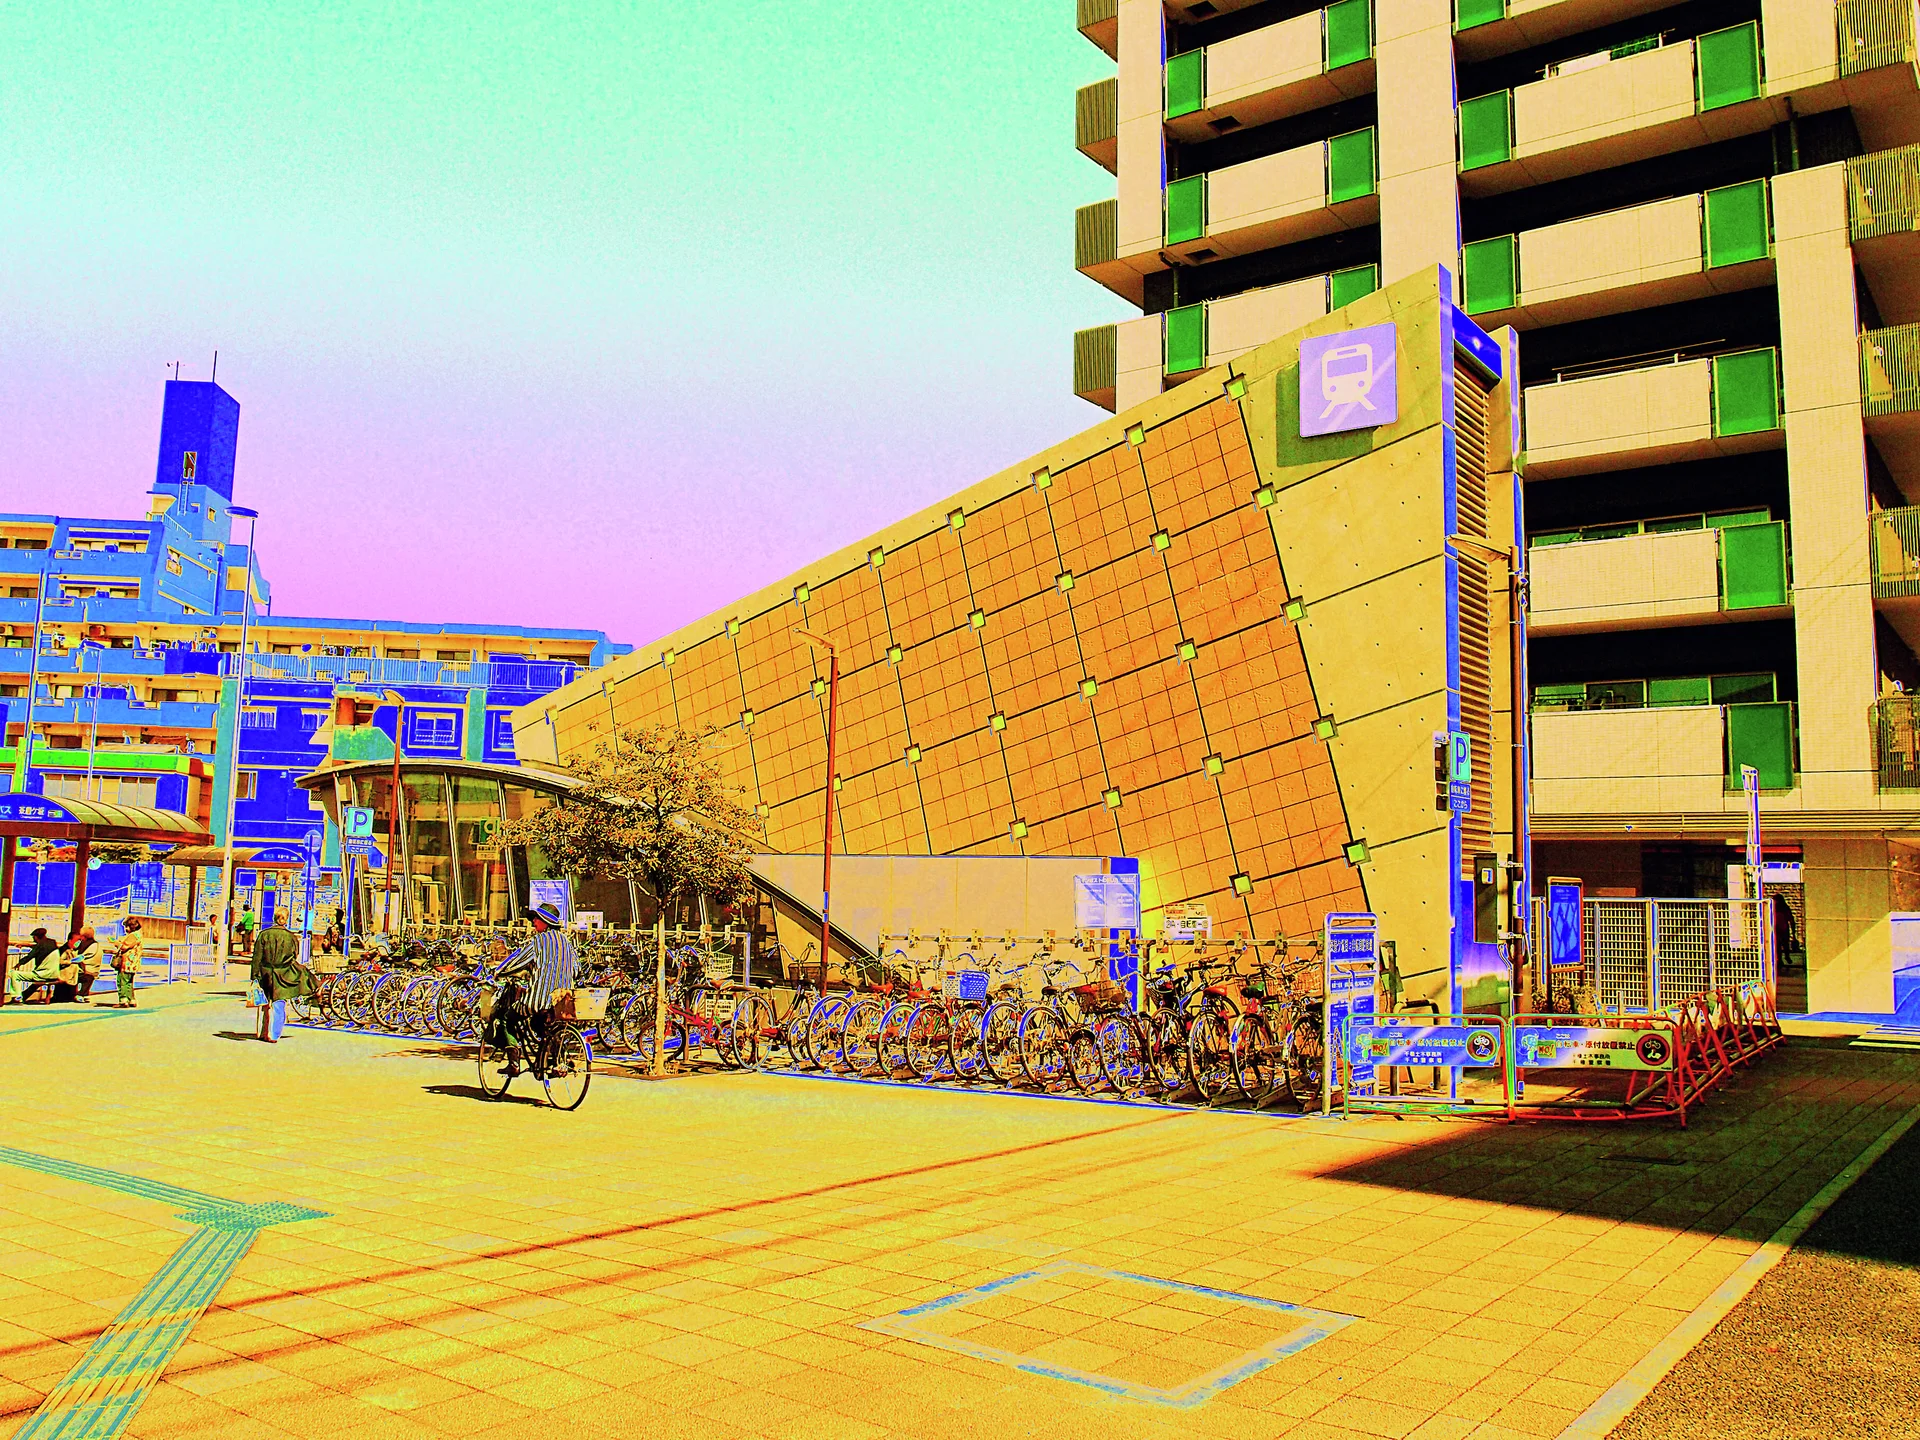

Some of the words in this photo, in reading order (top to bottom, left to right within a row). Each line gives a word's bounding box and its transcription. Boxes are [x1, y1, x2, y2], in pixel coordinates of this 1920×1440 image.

[1456, 737, 1467, 775] P
[352, 810, 368, 832] P
[1556, 1040, 1635, 1050] 自転車・原付放置禁止
